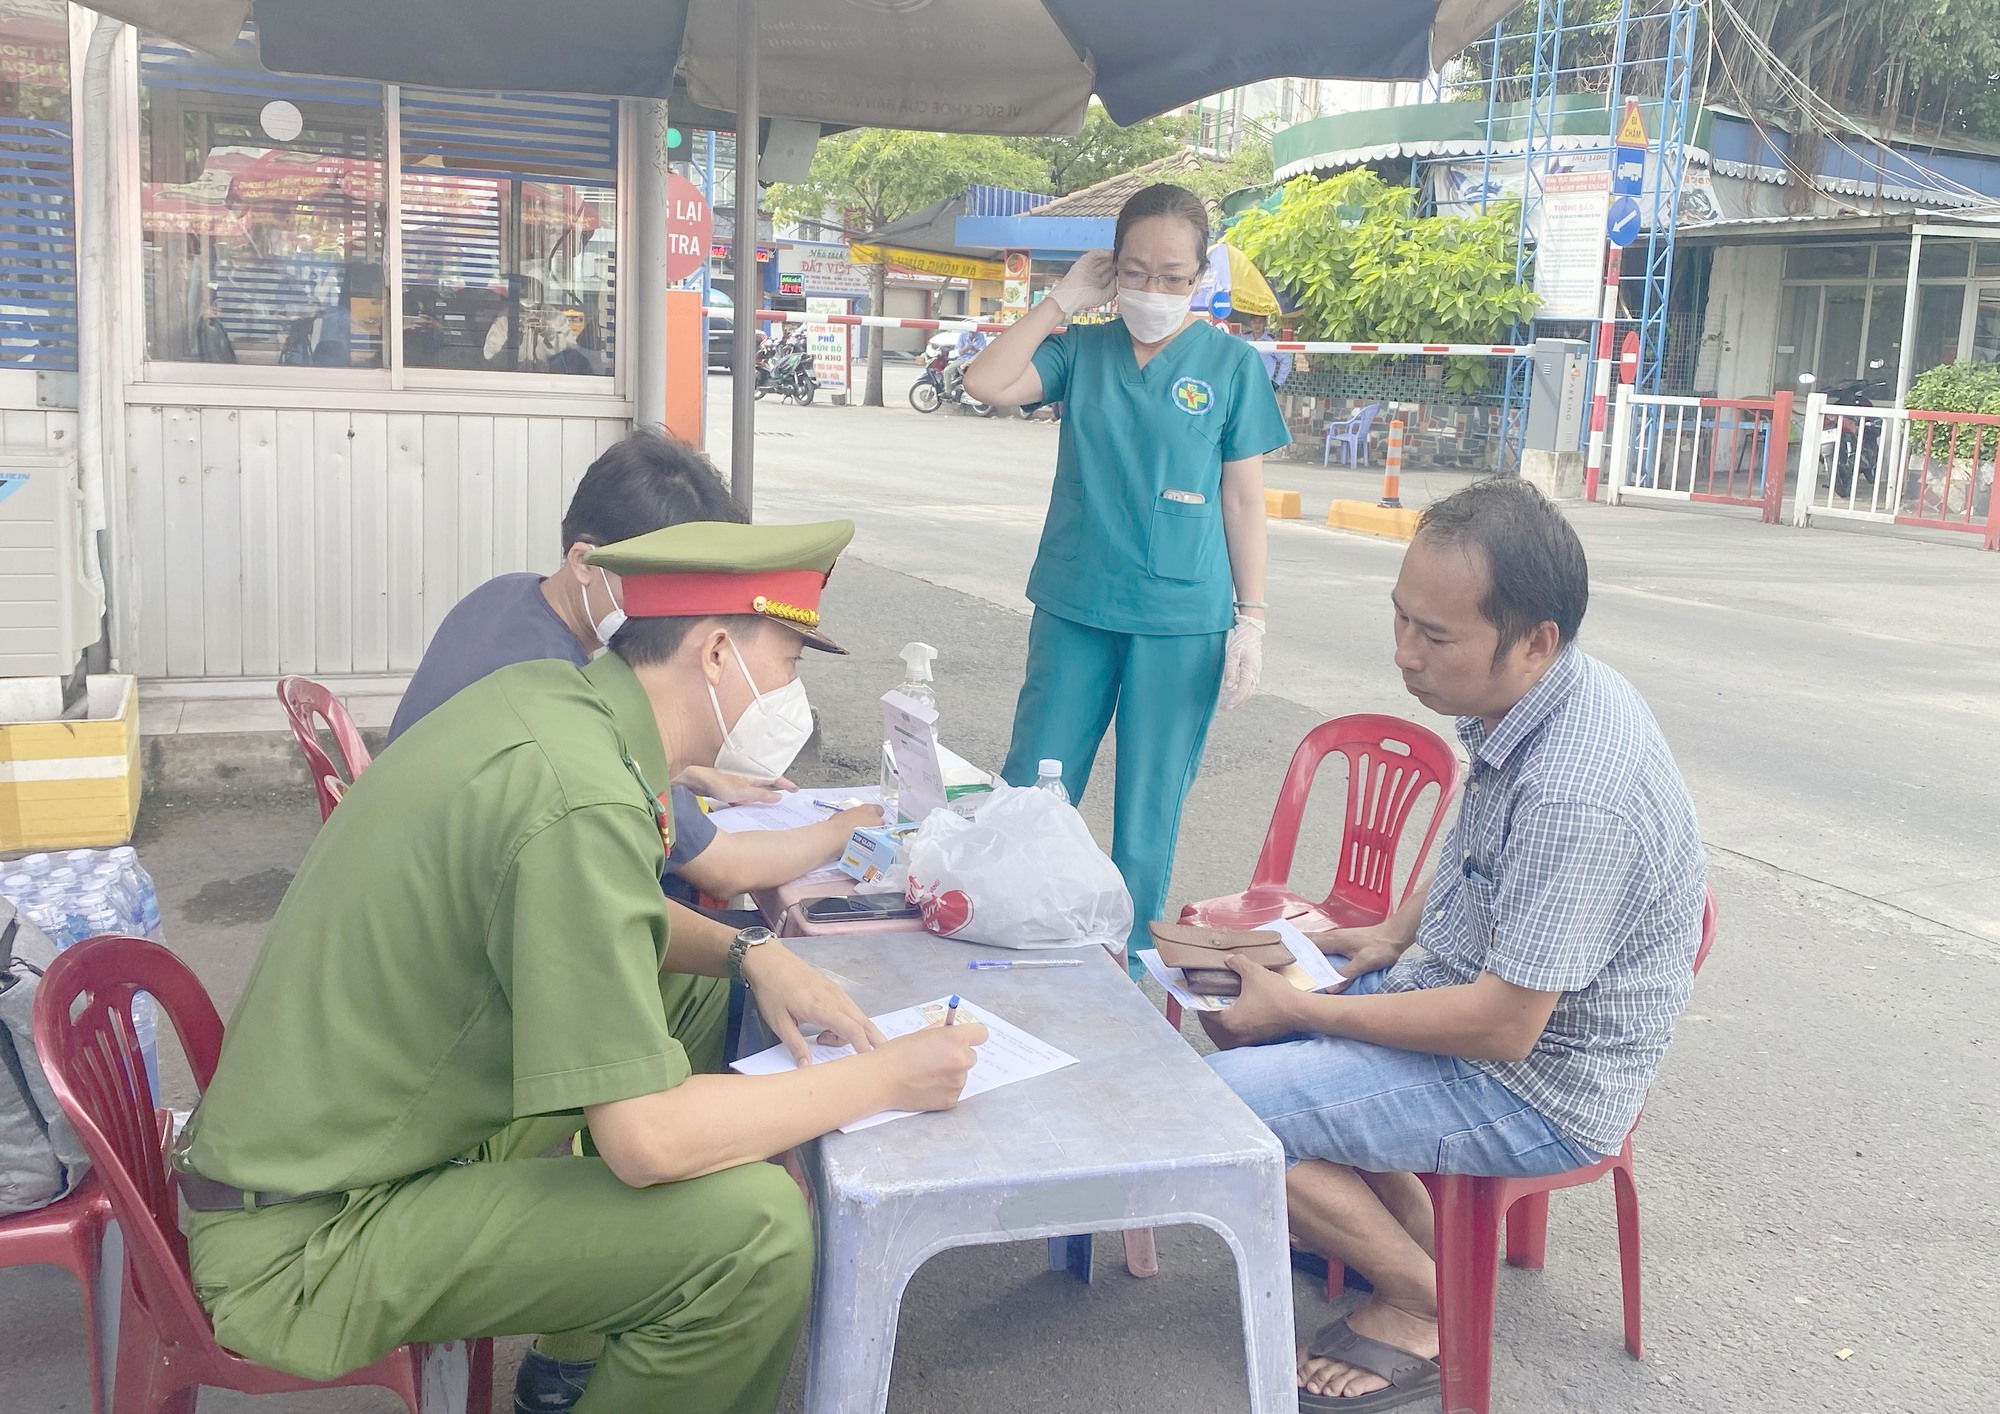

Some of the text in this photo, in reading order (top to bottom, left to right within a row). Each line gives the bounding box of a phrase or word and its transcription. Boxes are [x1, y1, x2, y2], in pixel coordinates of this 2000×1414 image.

[676, 199, 702, 226] LẠI
[668, 233, 700, 256] TRA
[818, 333, 835, 343] PHỞ
[825, 354, 842, 362] KHO
